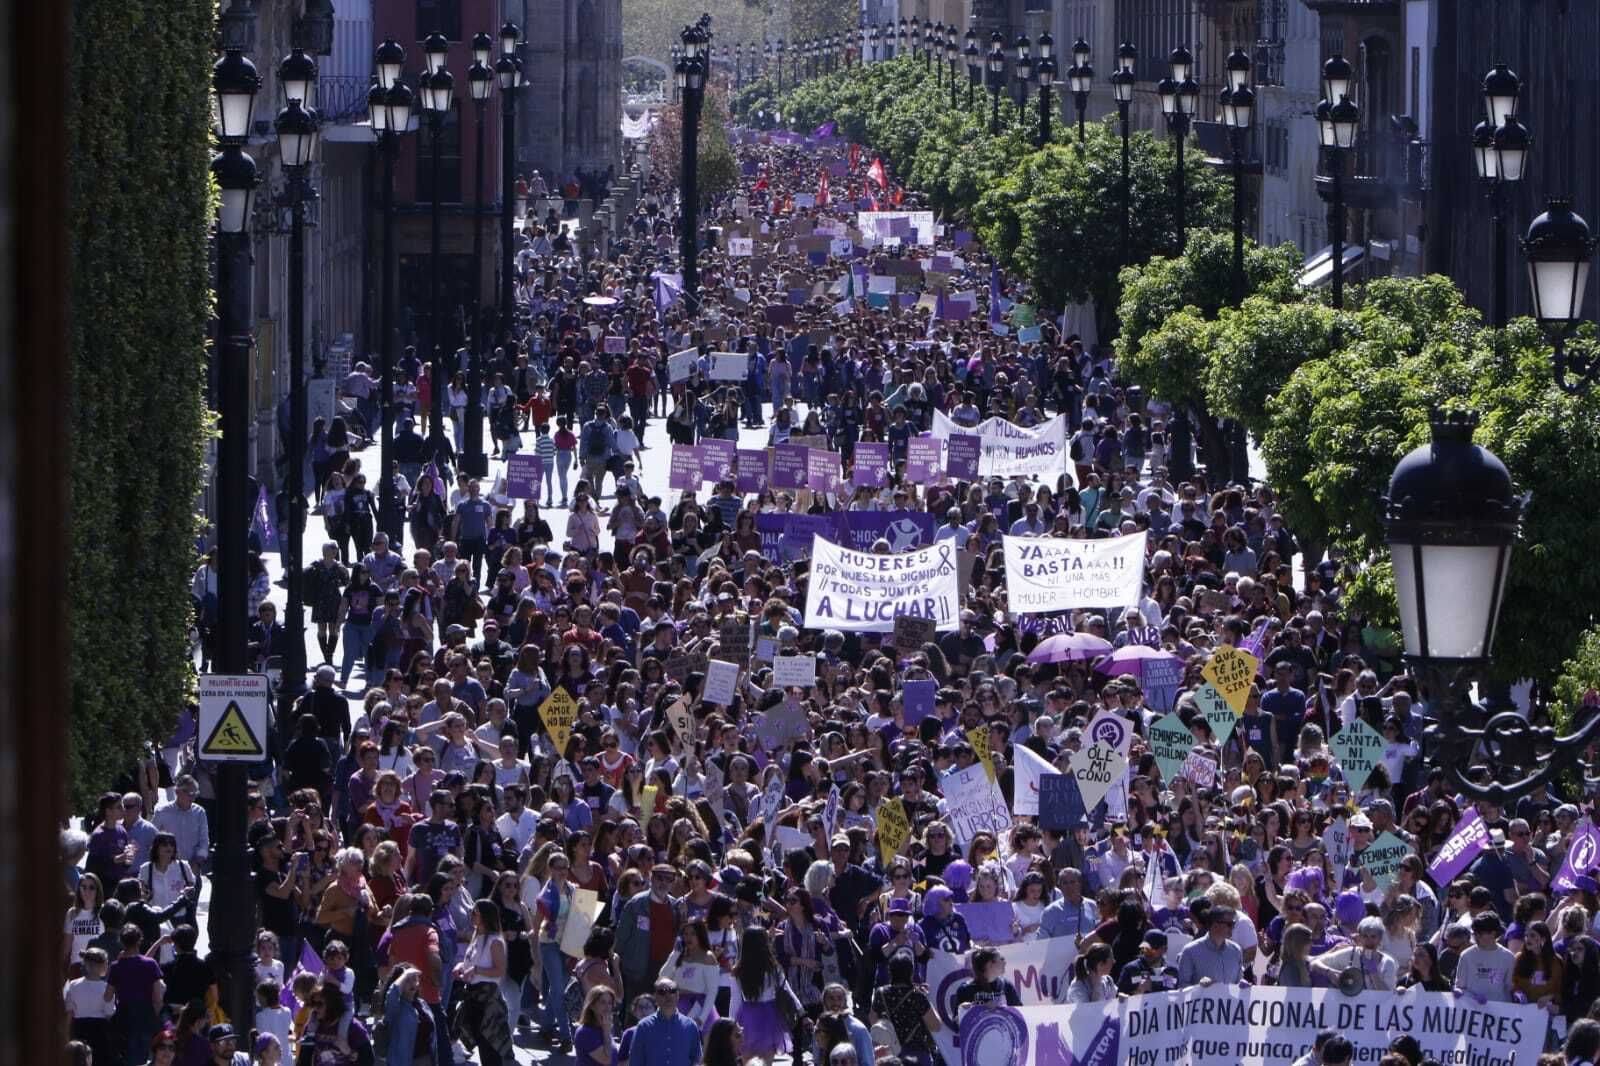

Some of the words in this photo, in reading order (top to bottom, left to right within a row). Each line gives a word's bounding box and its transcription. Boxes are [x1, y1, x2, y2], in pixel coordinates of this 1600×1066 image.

[840, 551, 929, 571] MUJERES
[816, 563, 838, 576] POR
[841, 570, 895, 583] NUESTRA
[900, 566, 951, 582] DIGNIDAD
[879, 584, 929, 598] JUNTAS
[1018, 591, 1057, 606] MUJER
[1073, 587, 1121, 599] HOMBRE
[816, 595, 833, 618] A
[1215, 651, 1236, 664] QUE
[1212, 665, 1226, 677] TE
[1216, 667, 1250, 685] CHUPE
[1207, 712, 1235, 723] PUTA
[1350, 722, 1363, 734] NI
[1150, 727, 1193, 745] FEMINISMO
[1336, 734, 1382, 748] SANTA
[1349, 747, 1363, 758] NI
[1090, 760, 1106, 772] MI
[1341, 759, 1373, 771] PUTA
[1129, 1001, 1159, 1037] DÍA
[1166, 997, 1328, 1031] INTERNACIONAL
[1337, 1003, 1366, 1030] DE
[1375, 1004, 1413, 1032] LAS
[1422, 1006, 1523, 1044] MUJERES
[1129, 1046, 1159, 1066] Hoy
[1192, 1040, 1230, 1060] que
